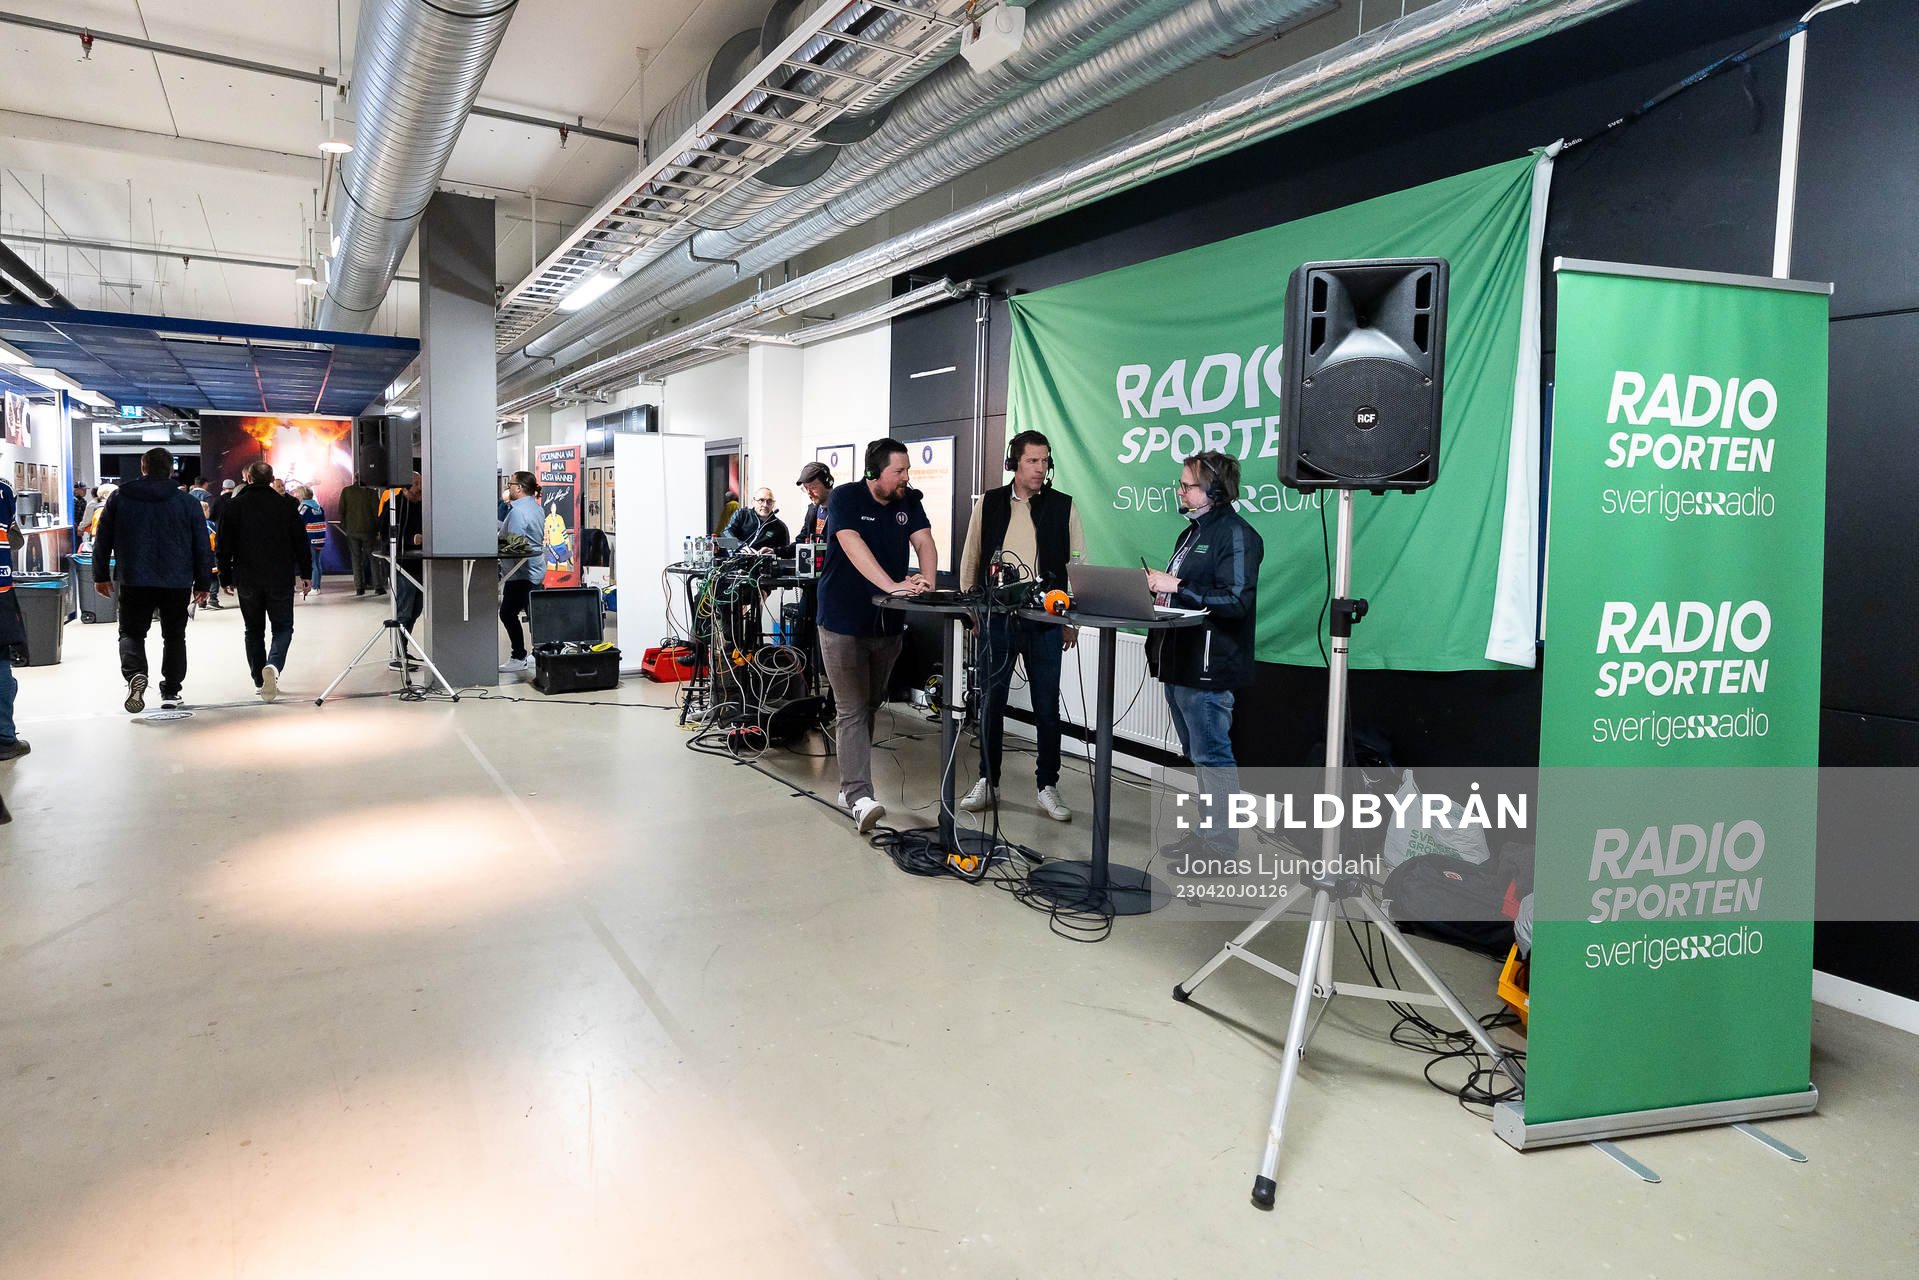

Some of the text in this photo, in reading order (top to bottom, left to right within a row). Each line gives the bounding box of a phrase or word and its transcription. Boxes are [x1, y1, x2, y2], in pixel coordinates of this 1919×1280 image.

[1357, 413, 1376, 423] RCF
[1606, 370, 1778, 431] RADIO
[1117, 415, 1280, 464] SPORTE
[1604, 431, 1775, 473] SPORTEN
[1596, 600, 1771, 654] RADIO
[1594, 659, 1769, 698] SPORTEN
[1588, 819, 1766, 881] RADIO
[1587, 877, 1763, 924] SPORTEN
